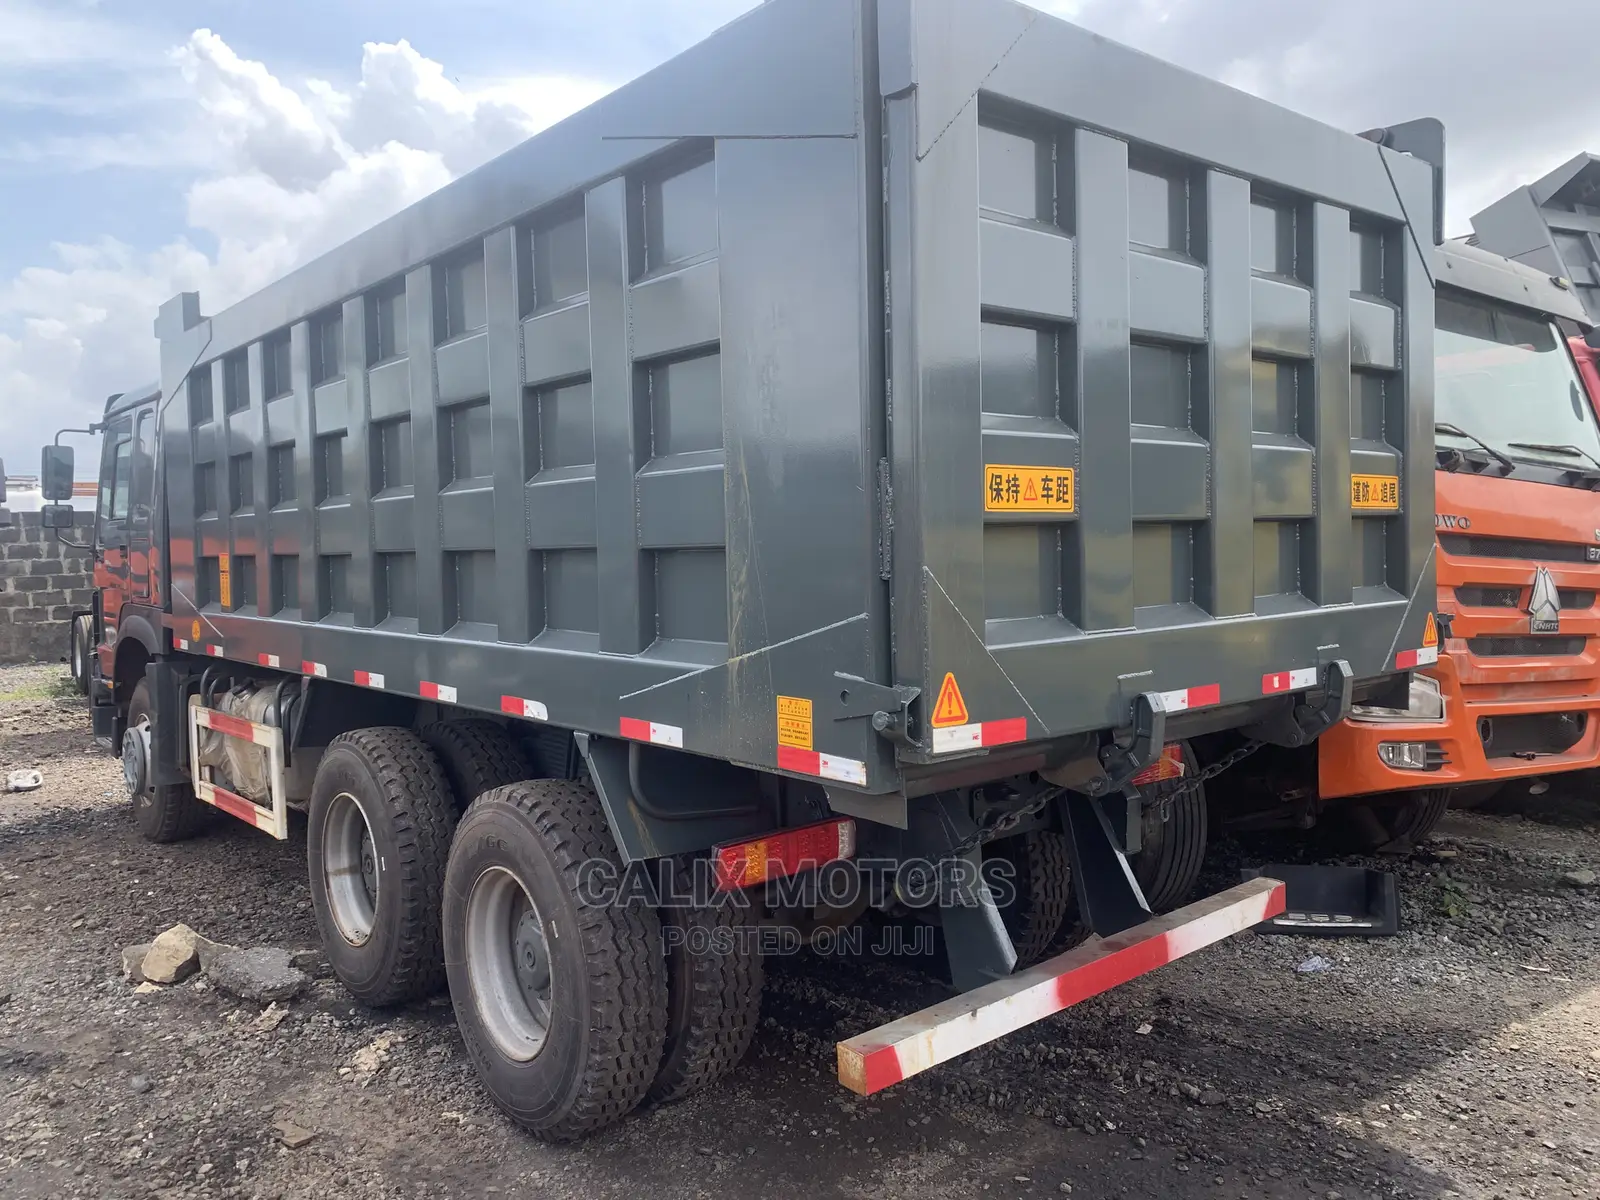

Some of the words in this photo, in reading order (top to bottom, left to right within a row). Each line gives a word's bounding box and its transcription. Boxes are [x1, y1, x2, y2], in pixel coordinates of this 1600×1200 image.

[989, 473, 1020, 504] 保持
[1041, 475, 1069, 504] 车距
[1353, 480, 1370, 503] 谨防
[1381, 481, 1396, 503] 追尾
